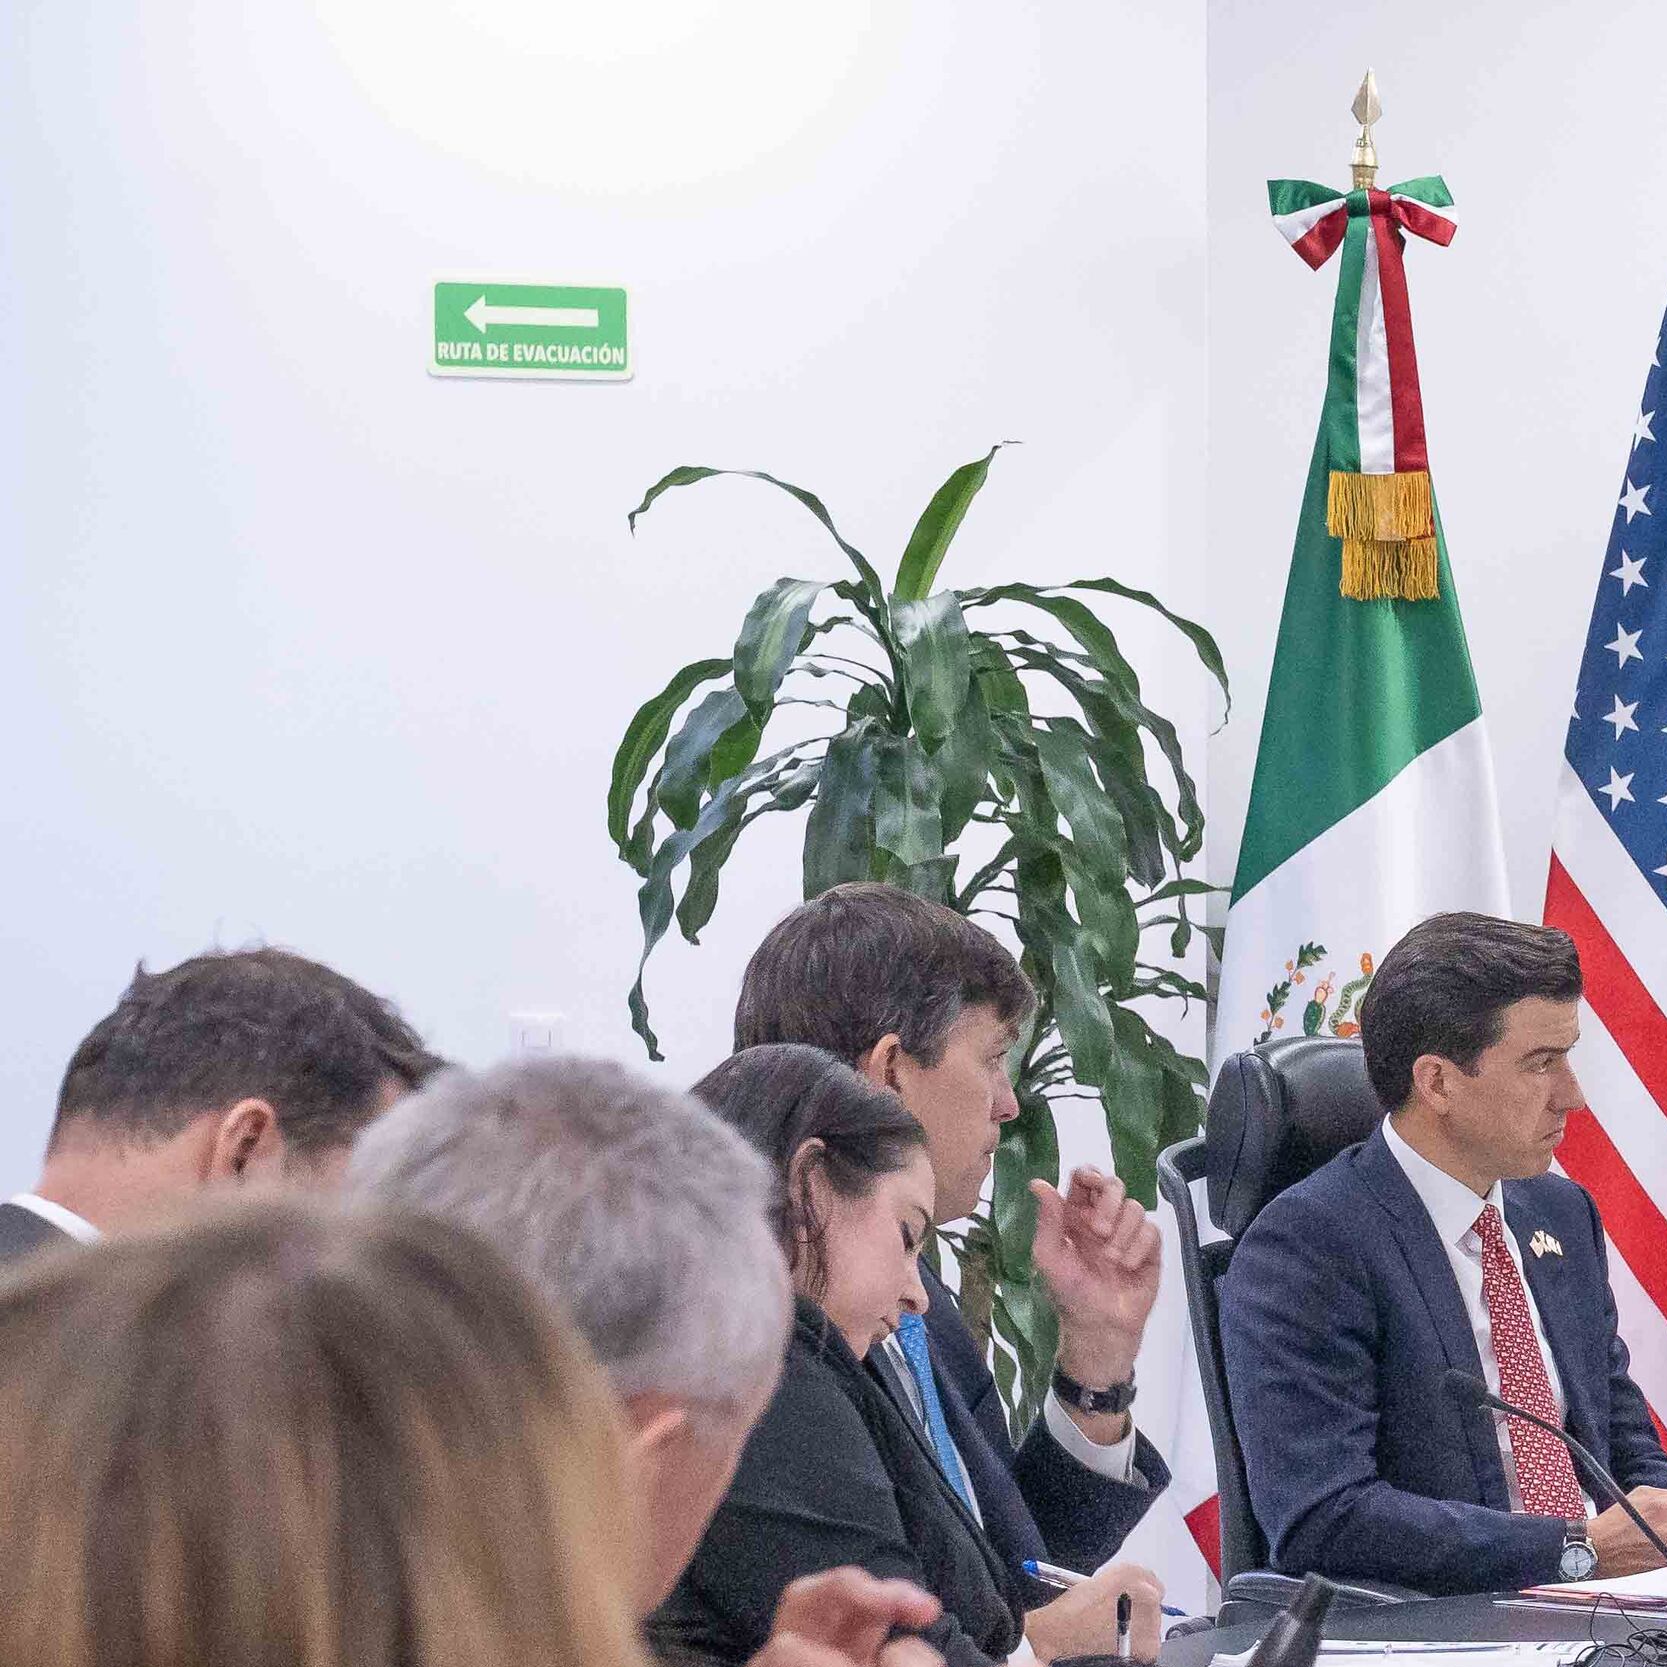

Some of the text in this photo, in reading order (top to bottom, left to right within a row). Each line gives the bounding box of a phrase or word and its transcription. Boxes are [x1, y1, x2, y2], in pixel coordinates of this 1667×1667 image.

[438, 342, 624, 364] RUTA DE EVACUACIÓN
